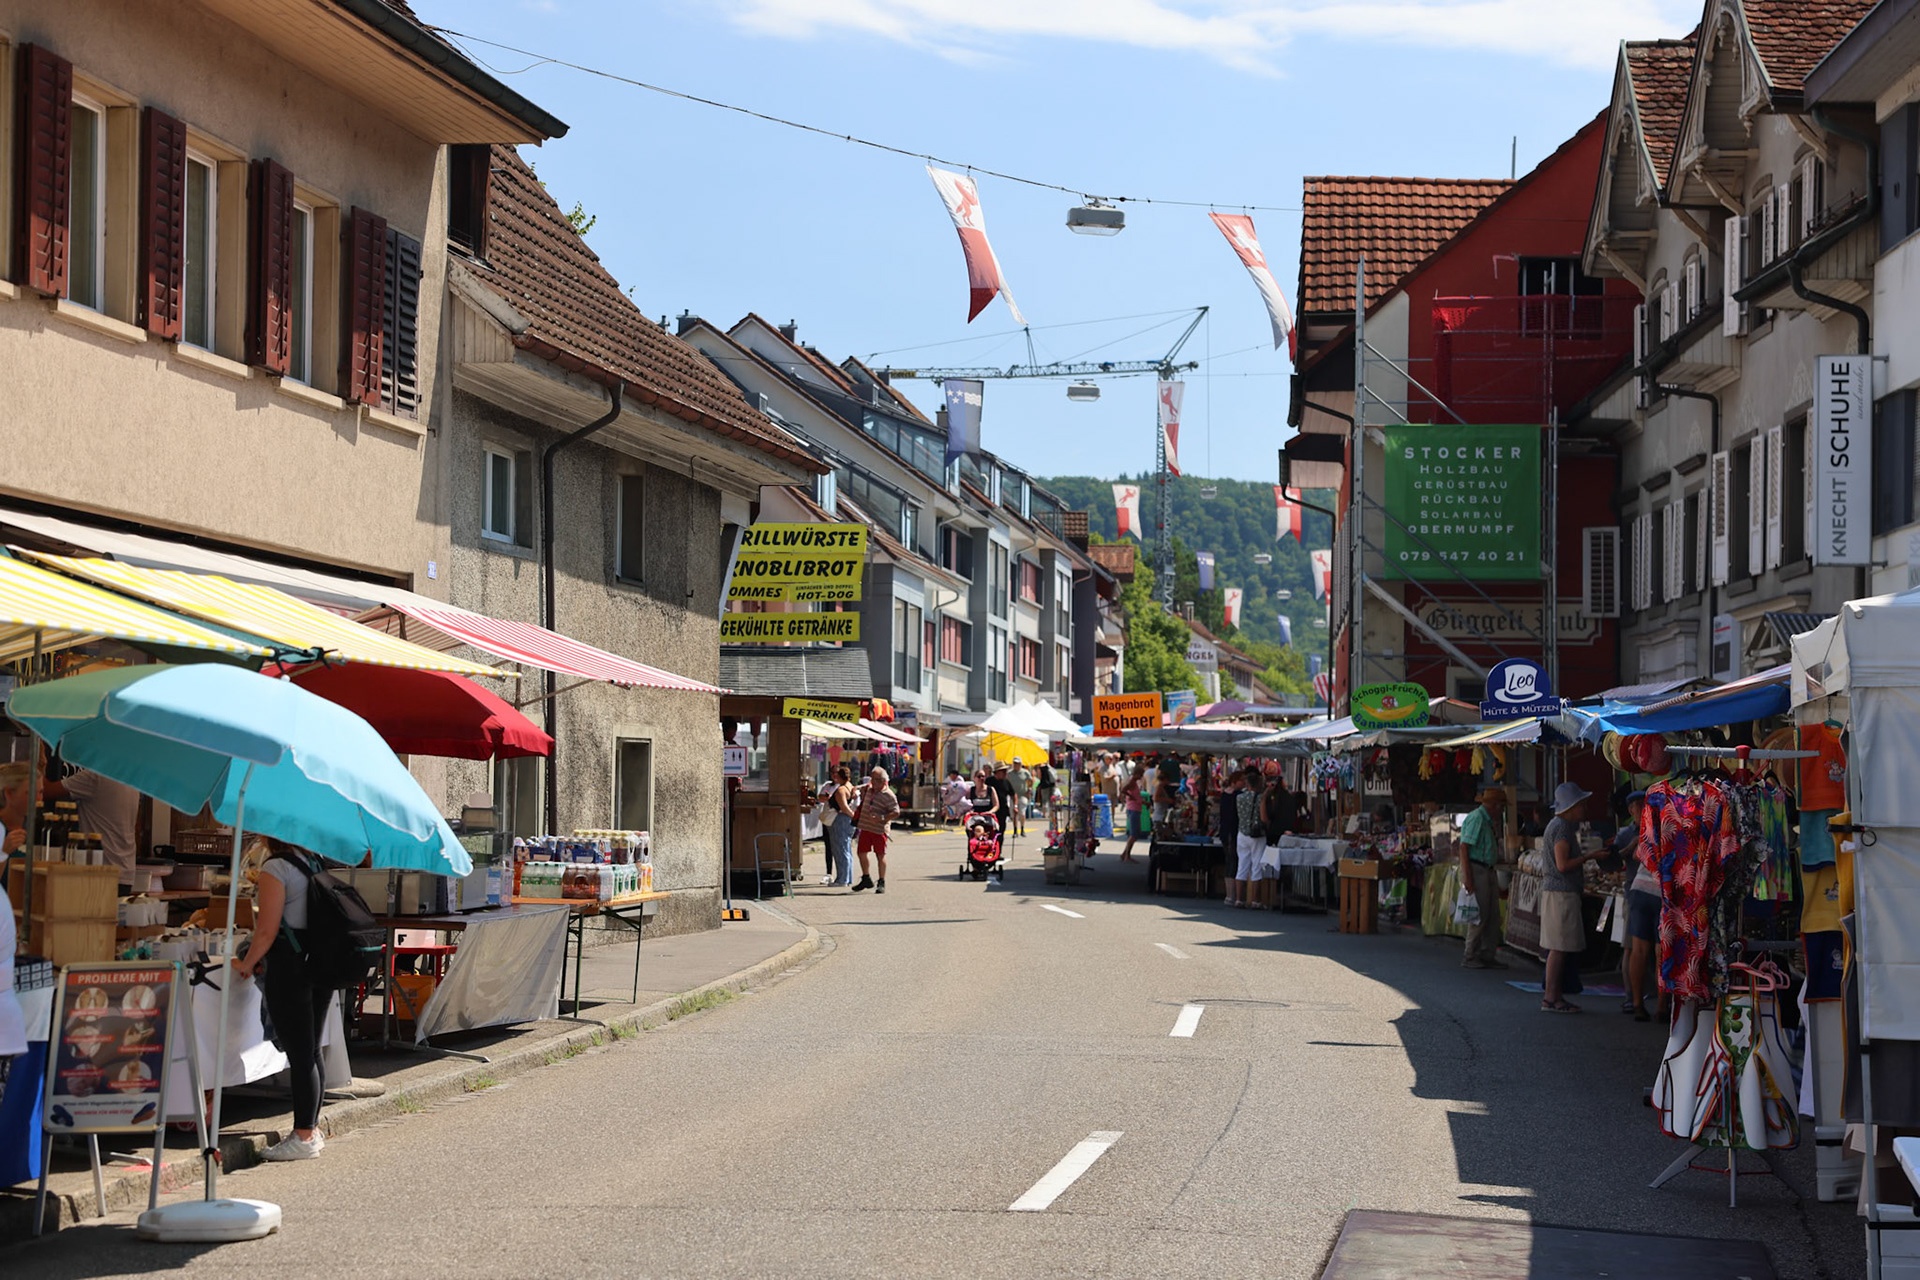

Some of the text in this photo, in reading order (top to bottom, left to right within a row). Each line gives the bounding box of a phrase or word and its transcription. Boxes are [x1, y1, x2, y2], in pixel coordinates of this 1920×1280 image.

[1404, 447, 1521, 459] STOCKER
[1830, 362, 1850, 557] KNECHT SCHUHE
[1420, 464, 1503, 474] HOLZBAU
[1414, 478, 1508, 489] GERÜSTBAU
[1421, 494, 1502, 504] RÜCKBAU
[1408, 525, 1515, 534] OBERMUMPF
[741, 527, 860, 548] RILLWÜRSTE
[1400, 551, 1524, 561] 079 547 40 21
[729, 586, 783, 598] OMMES
[796, 590, 854, 601] HOT-DOG
[720, 616, 853, 636] GEKÜHLTE GETRÄNKE
[1509, 672, 1535, 692] Leo
[1099, 698, 1155, 713] Magenbrot
[1483, 703, 1560, 717] HÜTE & MÜTZEN
[789, 706, 855, 721] GETRÄNKE
[1100, 714, 1155, 731] Rohner
[78, 972, 161, 984] PROBLEME MIT
